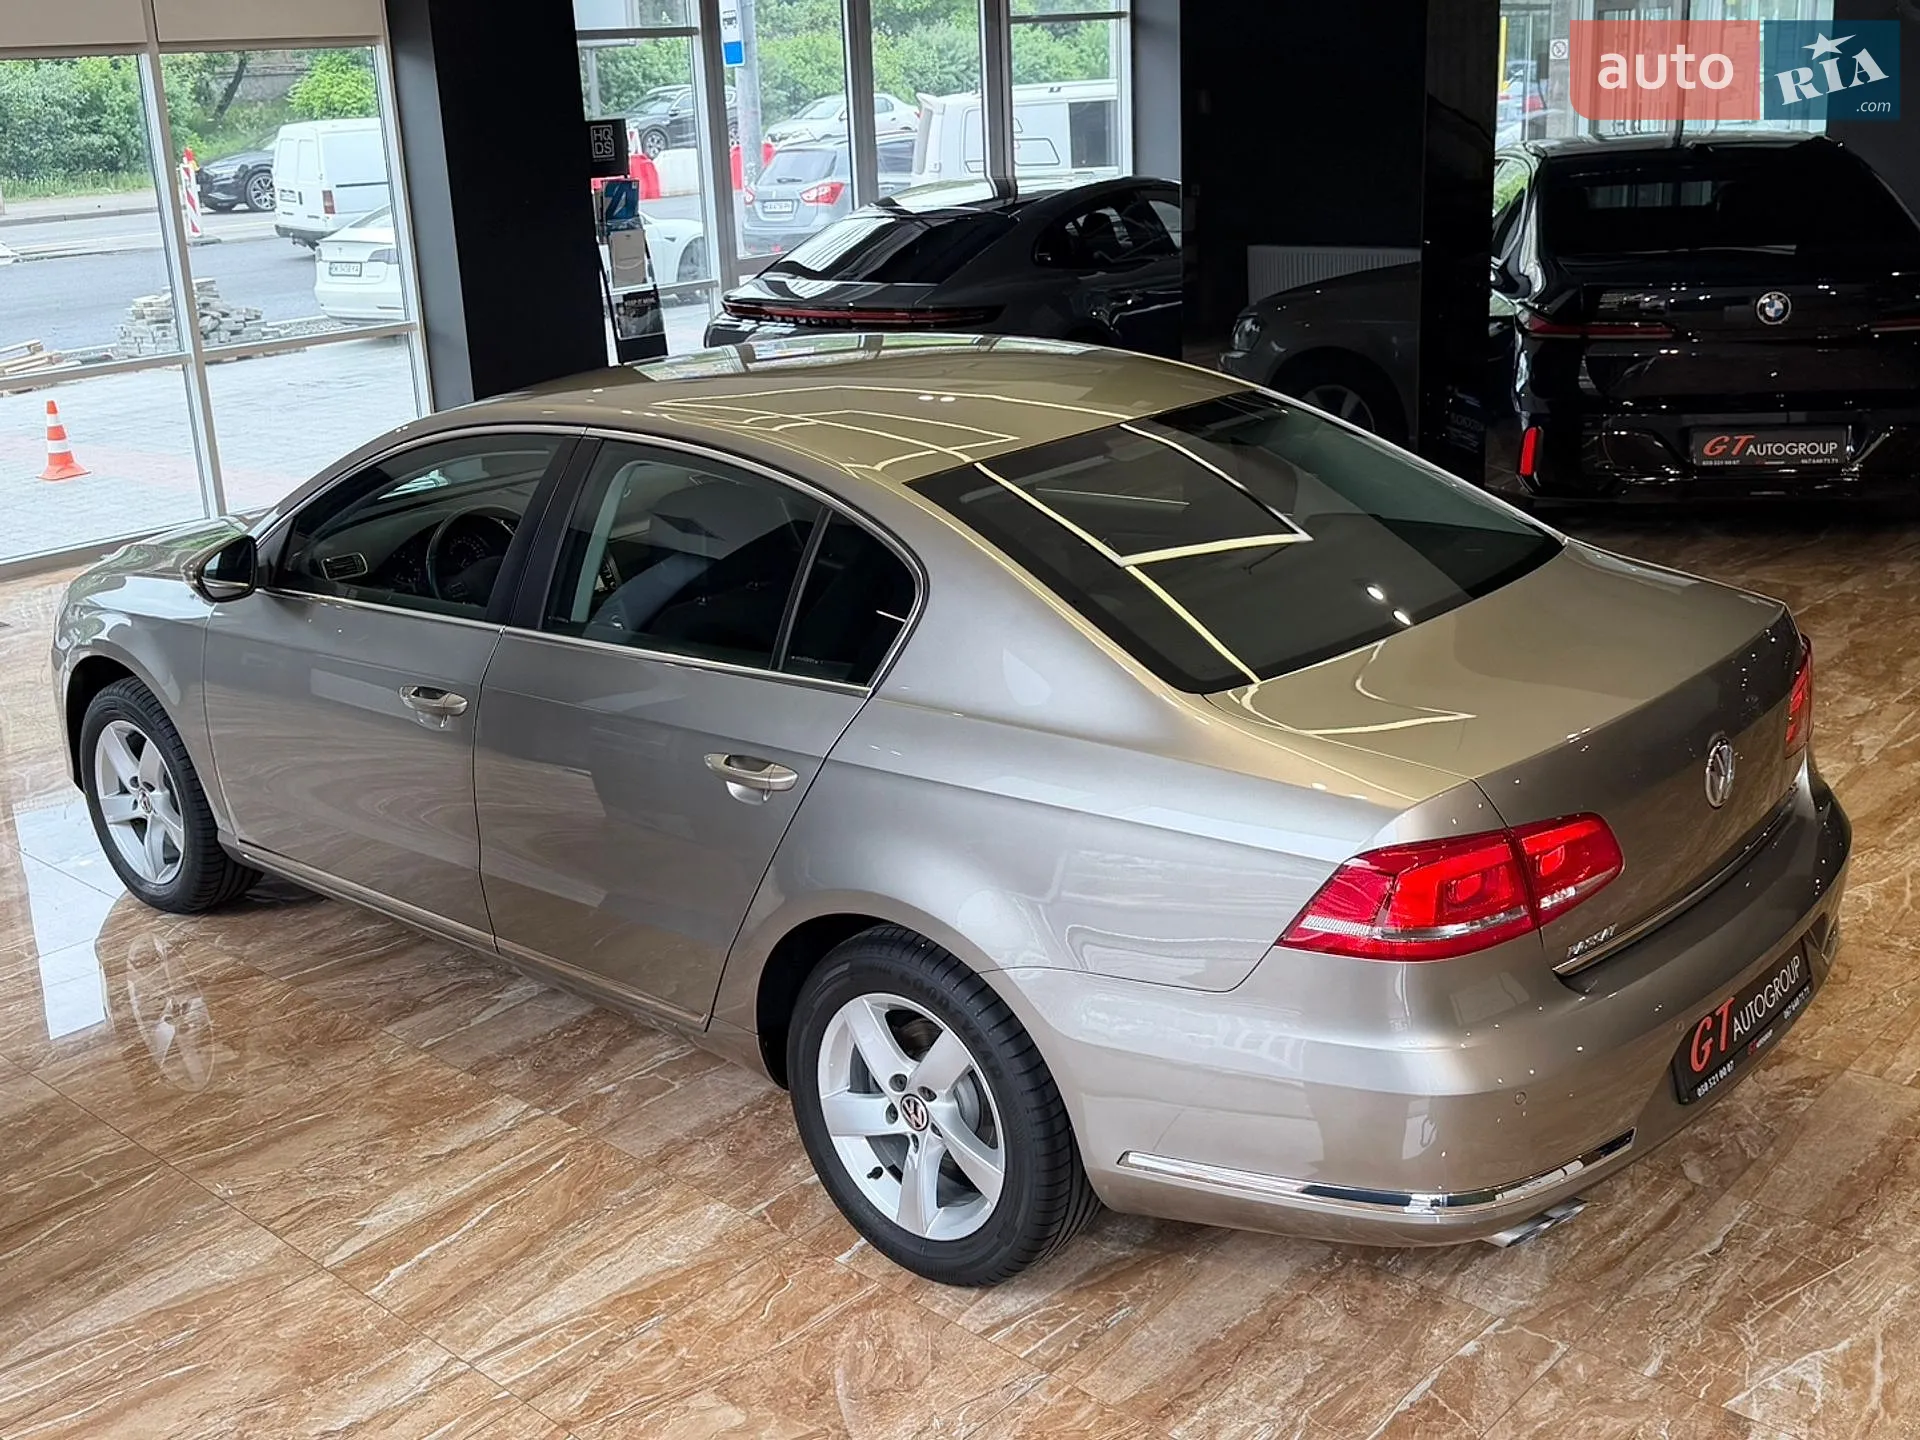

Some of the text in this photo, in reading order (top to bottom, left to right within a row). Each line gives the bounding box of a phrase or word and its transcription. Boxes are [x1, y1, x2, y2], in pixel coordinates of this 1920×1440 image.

[594, 127, 612, 141] HQ
[594, 141, 612, 155] DS
[1703, 434, 1838, 456] GT AUTOGROUP
[1690, 955, 1800, 1073] GT AUTOGROUP
